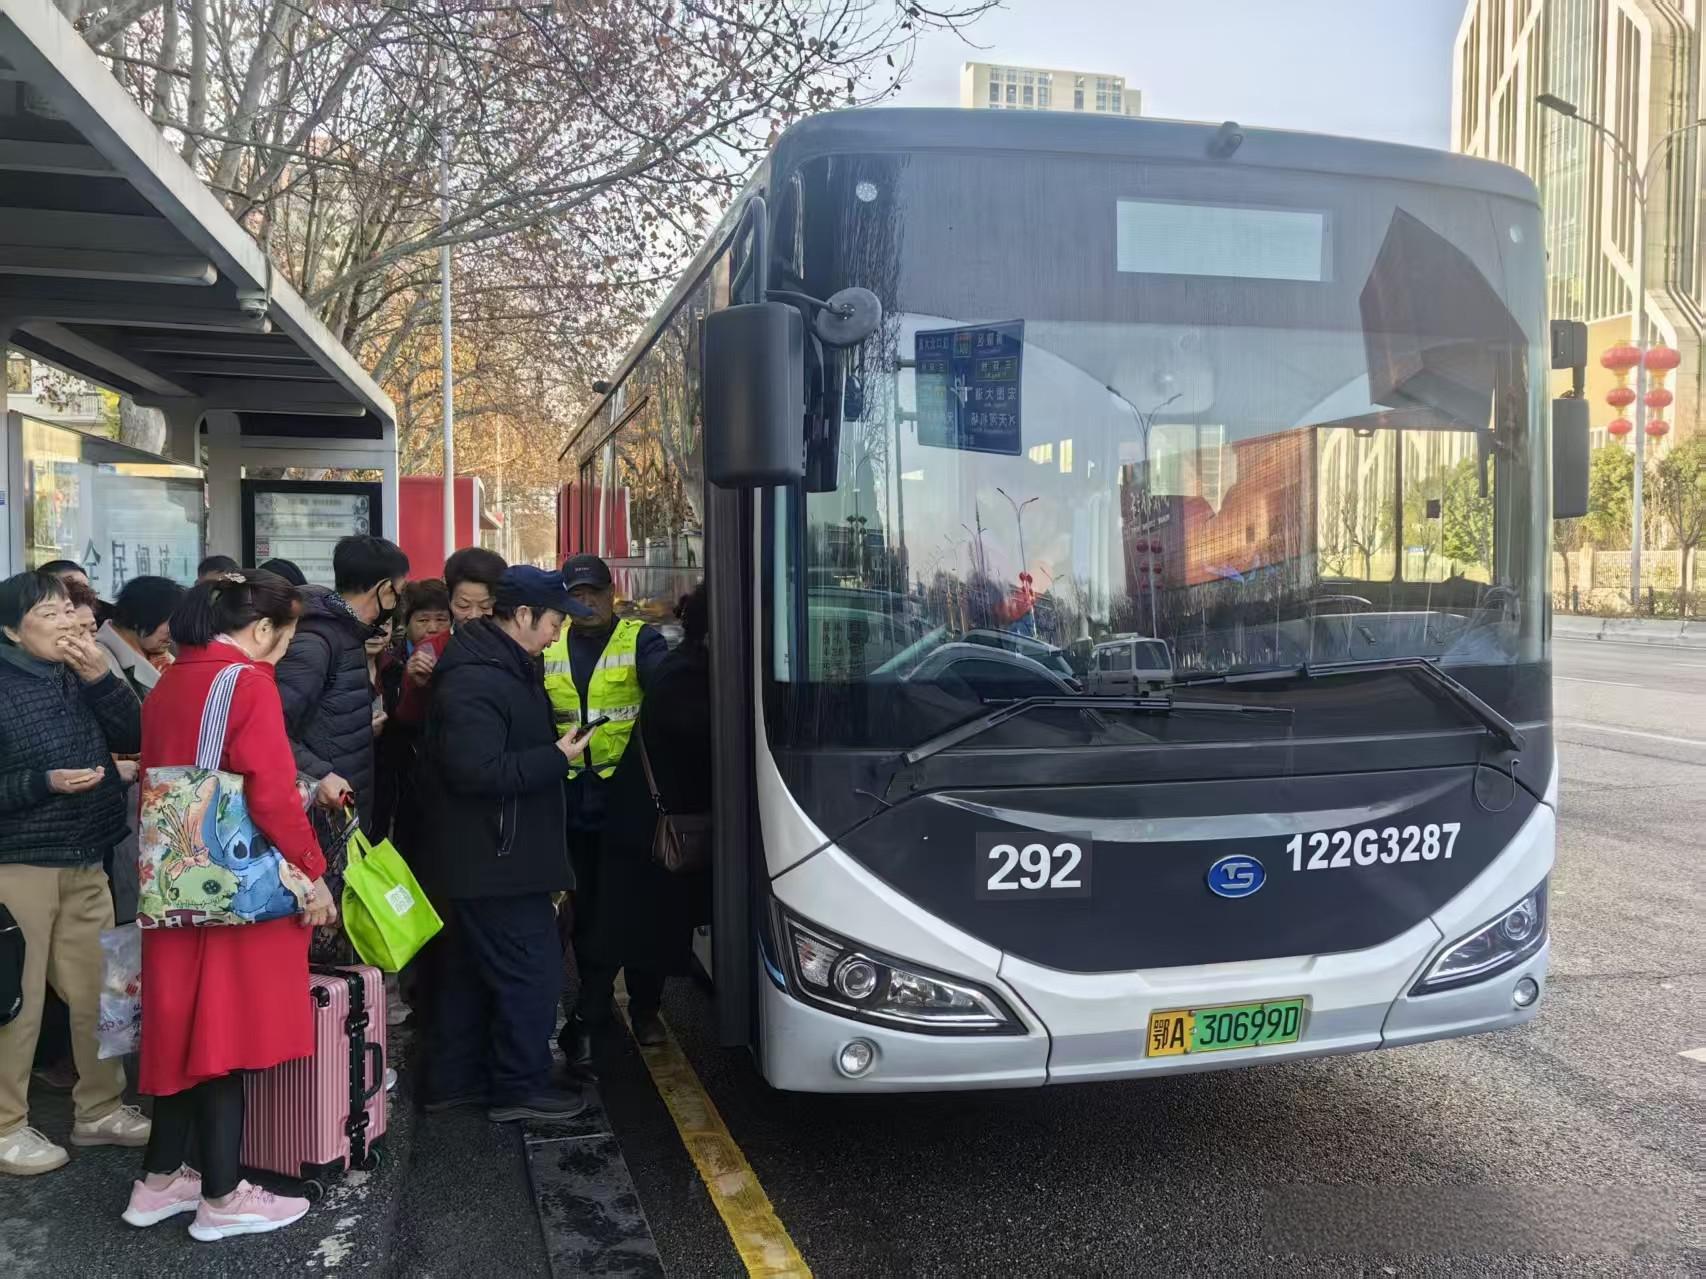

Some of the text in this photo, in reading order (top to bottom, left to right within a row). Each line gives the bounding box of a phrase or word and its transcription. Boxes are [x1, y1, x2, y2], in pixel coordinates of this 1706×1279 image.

[988, 843, 1082, 890] 292
[1287, 822, 1461, 872] 122G3287
[1200, 1006, 1299, 1045] 30699D
